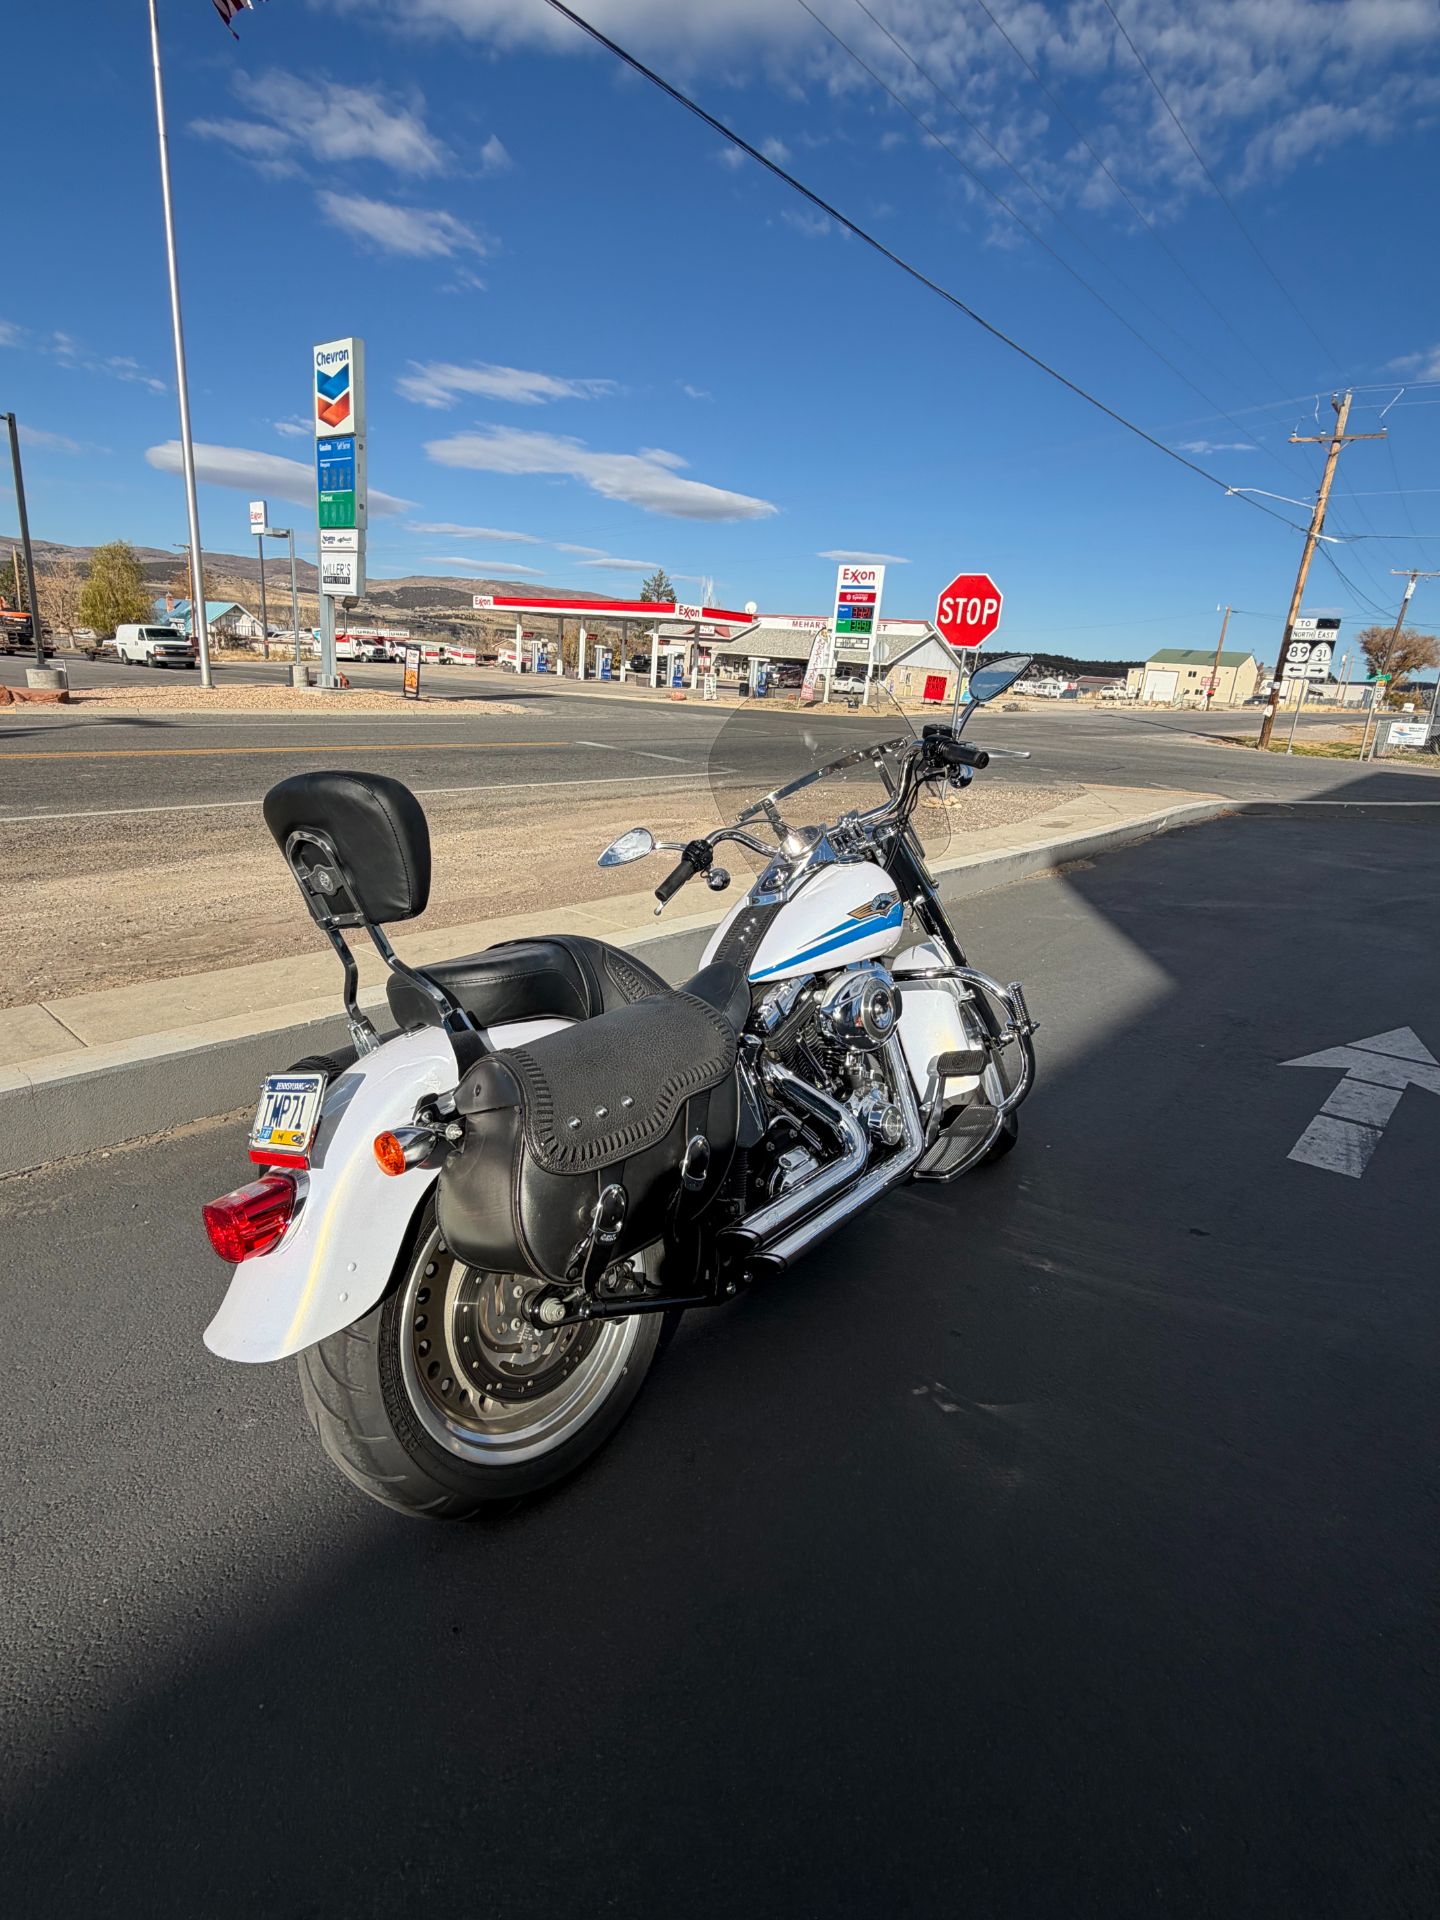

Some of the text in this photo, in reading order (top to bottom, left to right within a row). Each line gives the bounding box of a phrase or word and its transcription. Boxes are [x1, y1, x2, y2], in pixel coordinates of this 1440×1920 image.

[316, 349, 349, 366] Chevron
[323, 563, 351, 576] MILLER'S
[843, 569, 876, 584] Exxon
[475, 596, 491, 608] Exxon
[679, 605, 700, 619] Exxon
[940, 597, 998, 625] STOP
[1317, 630, 1334, 639] EAST
[1289, 646, 1327, 658] 89 31
